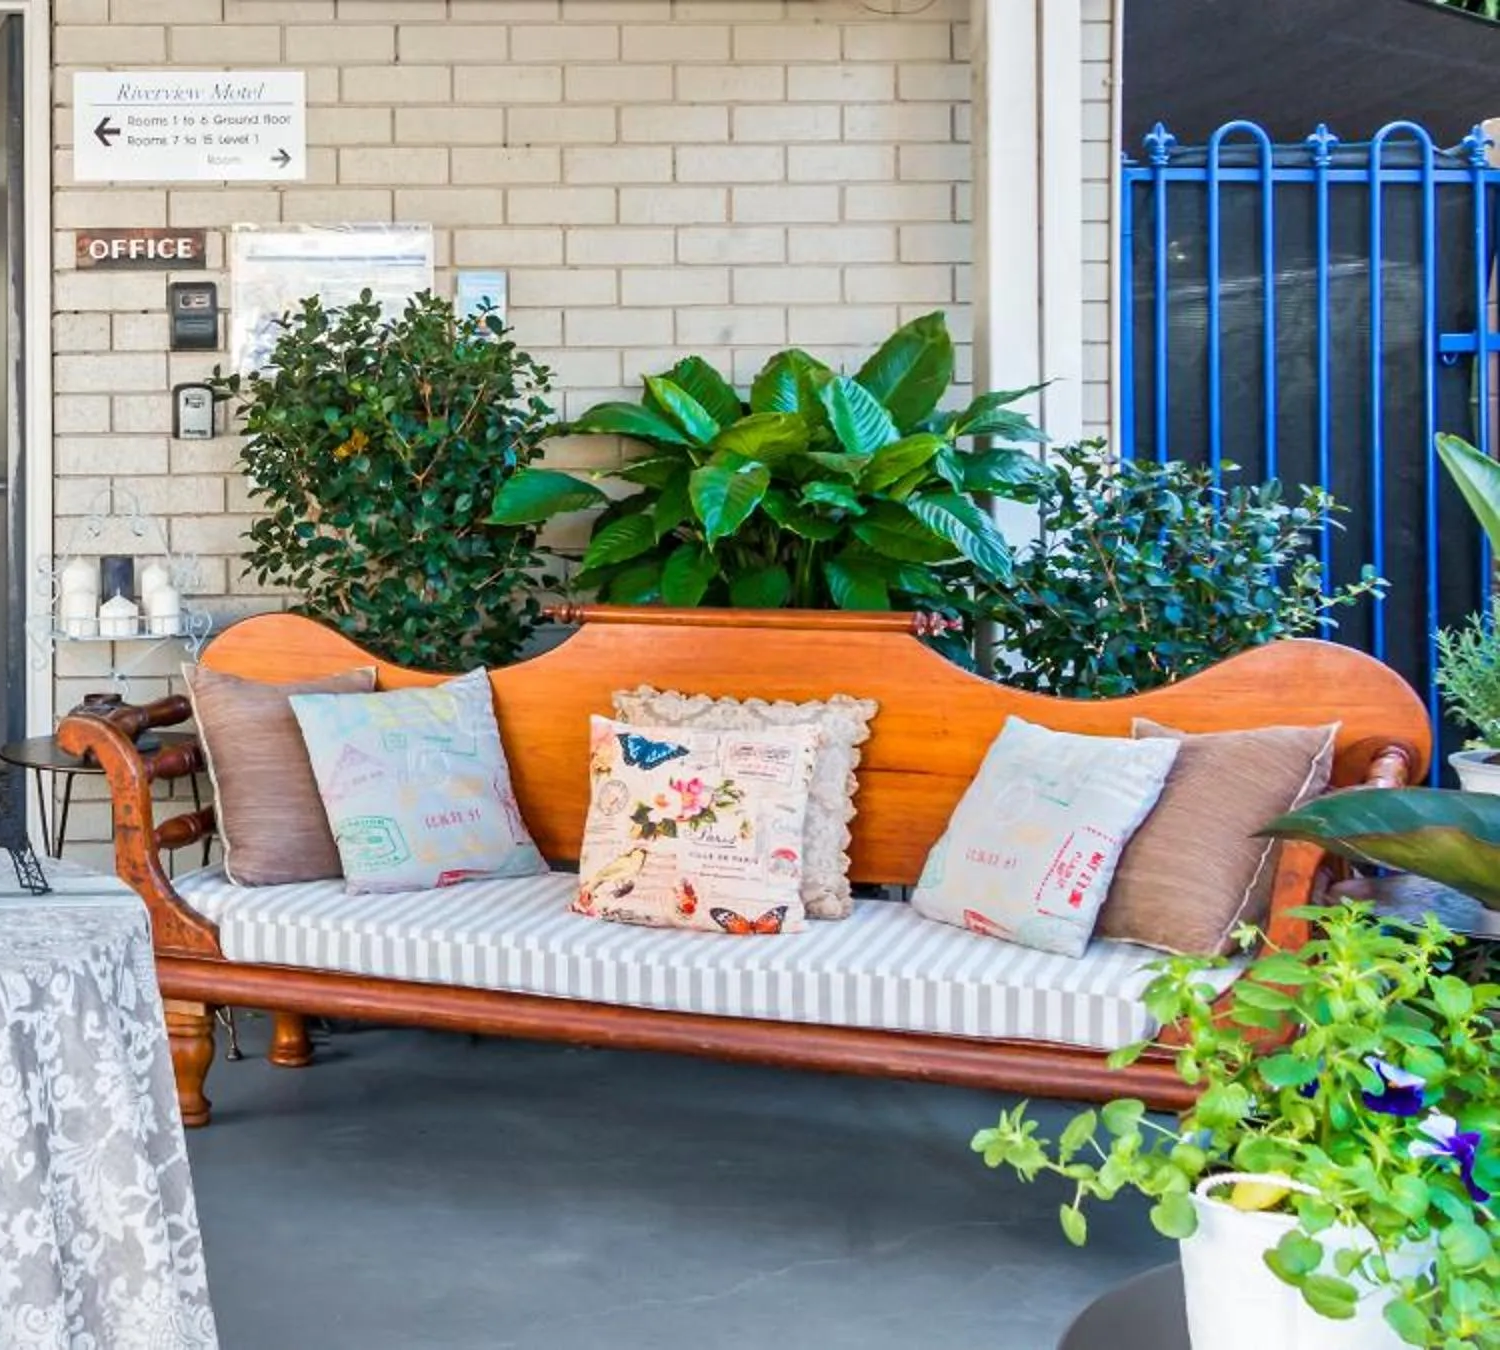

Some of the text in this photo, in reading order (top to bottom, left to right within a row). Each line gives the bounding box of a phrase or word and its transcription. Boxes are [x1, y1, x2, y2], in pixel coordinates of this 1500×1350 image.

[116, 82, 266, 101] Riverview Motel
[127, 115, 168, 127] Rooms
[183, 115, 195, 126] to
[213, 114, 259, 126] Ground
[127, 135, 168, 147] Rooms
[184, 135, 196, 146] to
[219, 134, 250, 145] Level
[88, 237, 194, 260] OFFICE
